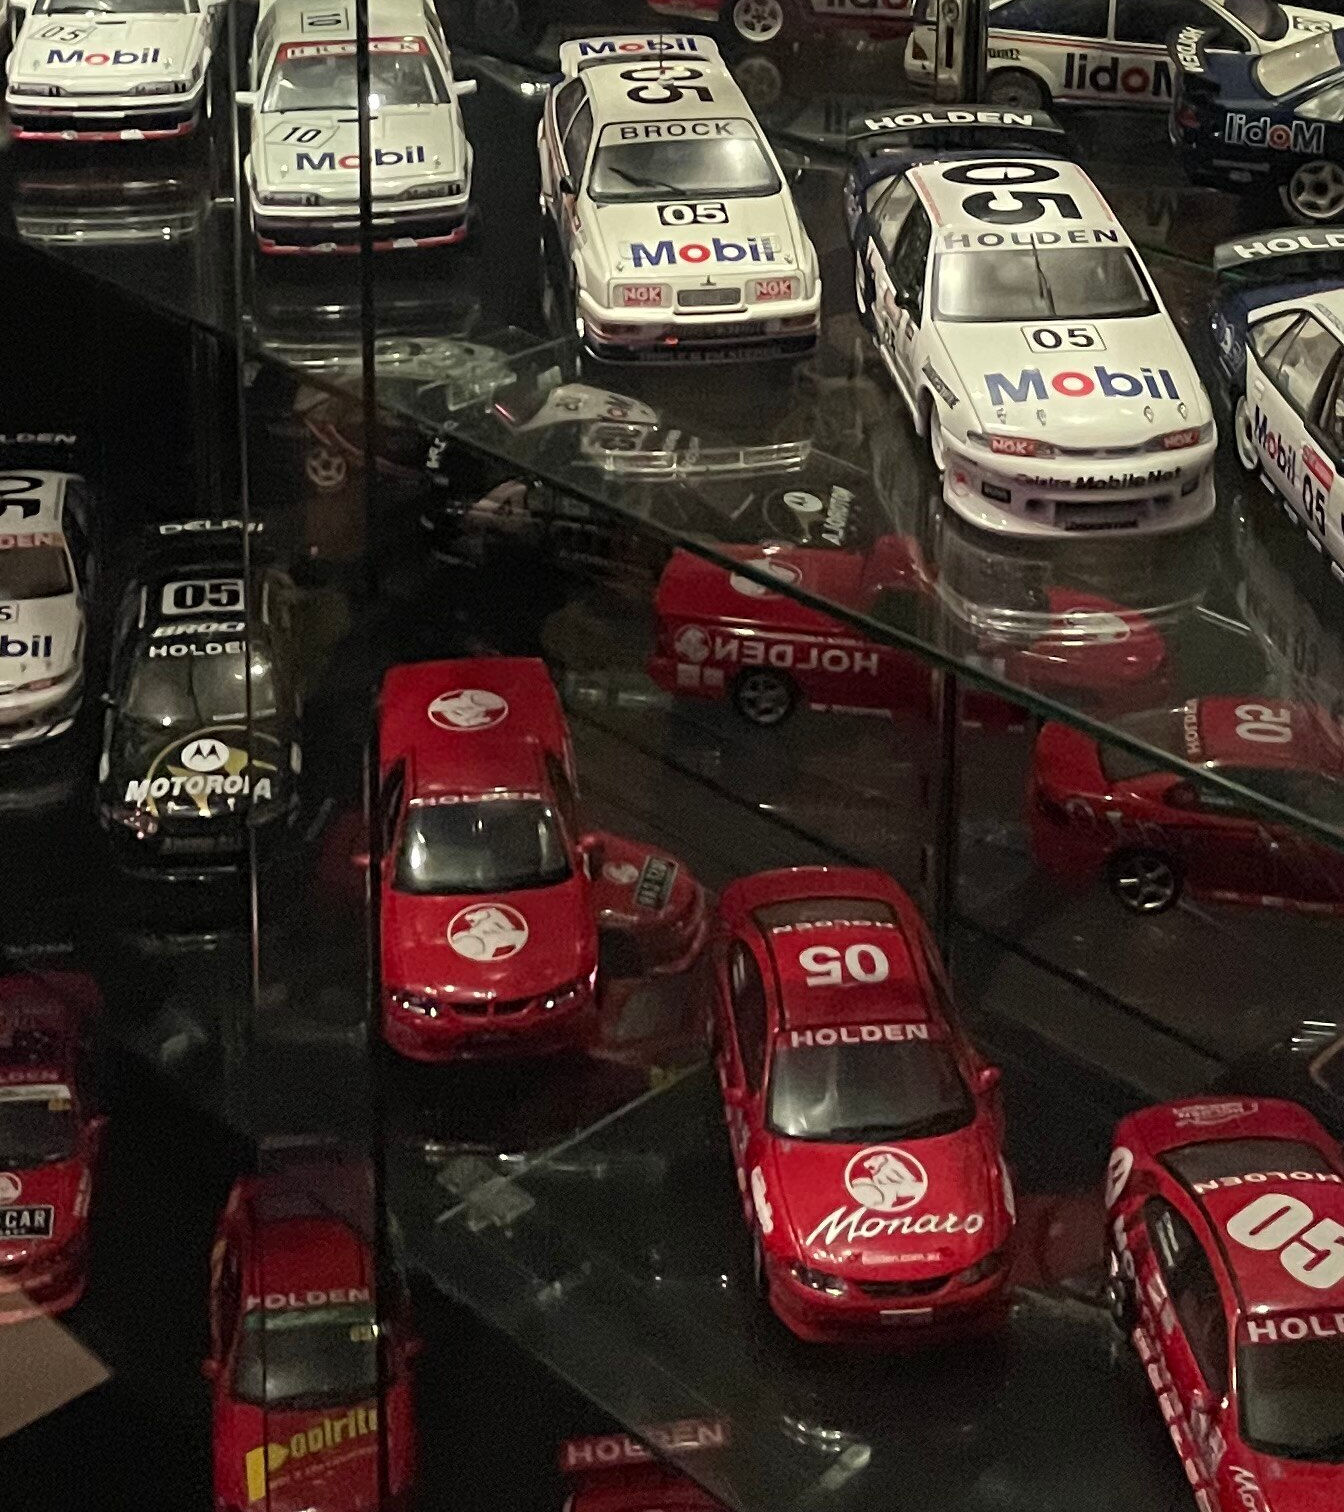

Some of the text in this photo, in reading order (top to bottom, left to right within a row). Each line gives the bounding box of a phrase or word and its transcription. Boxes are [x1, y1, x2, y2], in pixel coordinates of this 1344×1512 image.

[41, 24, 81, 42] 05
[46, 47, 161, 66] Mobil
[579, 37, 699, 56] Mobil
[619, 66, 714, 105] 05
[619, 121, 733, 140] BROCK
[864, 110, 1034, 131] HOLDEN
[283, 125, 323, 144] 10
[295, 145, 425, 171] Mobil
[942, 161, 1084, 225] 05
[660, 203, 725, 225] 05
[943, 228, 1120, 251] HOLDEN
[631, 237, 775, 267] Mobil
[624, 287, 661, 304] NGK
[1032, 327, 1096, 350] 05
[983, 365, 1181, 407] Mobil
[1254, 404, 1297, 488] Mobil
[1301, 482, 1328, 537] 05
[172, 582, 243, 610] 05
[124, 774, 272, 803] MOTOROLA
[798, 943, 890, 987] 05
[791, 1023, 929, 1048] HOLDEN
[4, 1209, 46, 1230] CAR
[805, 1206, 986, 1246] Monaro
[246, 1288, 370, 1312] HOLDEN
